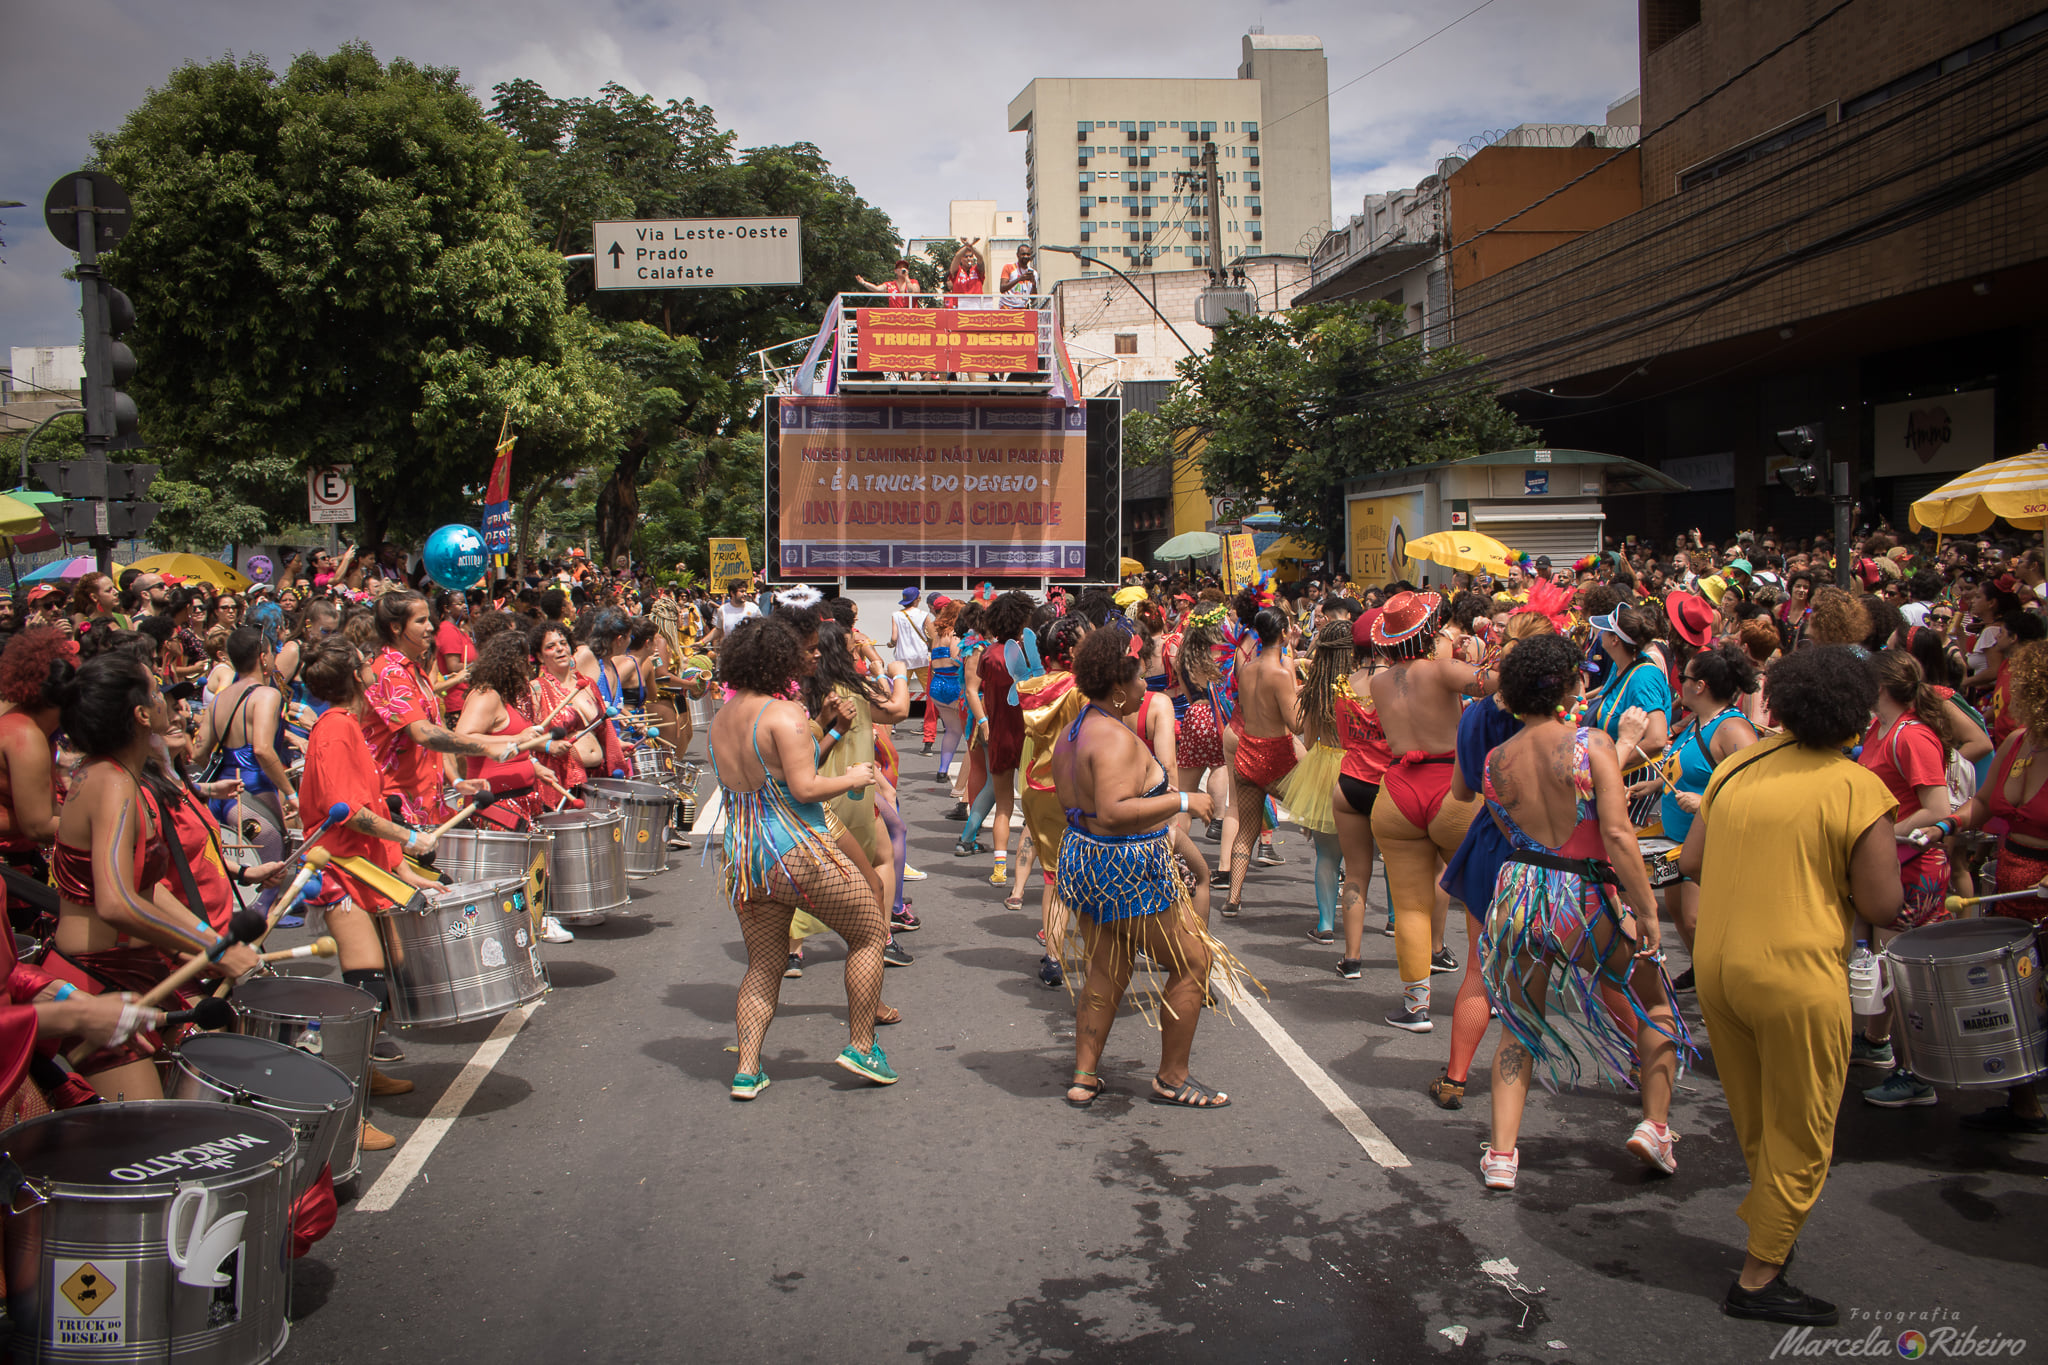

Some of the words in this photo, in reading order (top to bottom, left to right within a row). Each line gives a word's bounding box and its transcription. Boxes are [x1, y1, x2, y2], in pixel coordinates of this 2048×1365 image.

[636, 227, 664, 241] Via
[674, 225, 789, 241] Leste-Oeste
[636, 247, 688, 260] Prado
[637, 265, 714, 280] Calafate
[936, 333, 961, 346] DO
[967, 333, 1036, 346] DESEJO
[801, 447, 851, 462] NOSSO
[856, 445, 937, 463] CAMINHÃO
[941, 445, 973, 463] NÃO
[978, 448, 1002, 463] VAI
[1007, 448, 1065, 464] PARAR!
[323, 474, 338, 498] E
[830, 467, 843, 491] É
[847, 474, 859, 491] A
[864, 474, 926, 492] TRUCK
[931, 474, 959, 492] DO
[964, 474, 1038, 493] DESEJO
[802, 500, 942, 525] INVADINDO
[945, 501, 967, 525] A
[970, 501, 1063, 526] CIDADE
[2024, 503, 2048, 514] SKO
[1357, 553, 1386, 573] LEVE
[1963, 1013, 2010, 1031] MARCATTO
[109, 1133, 270, 1182] MARCATTO
[57, 1320, 105, 1331] TRUCK
[108, 1321, 121, 1329] DO
[61, 1331, 119, 1344] DESEJO
